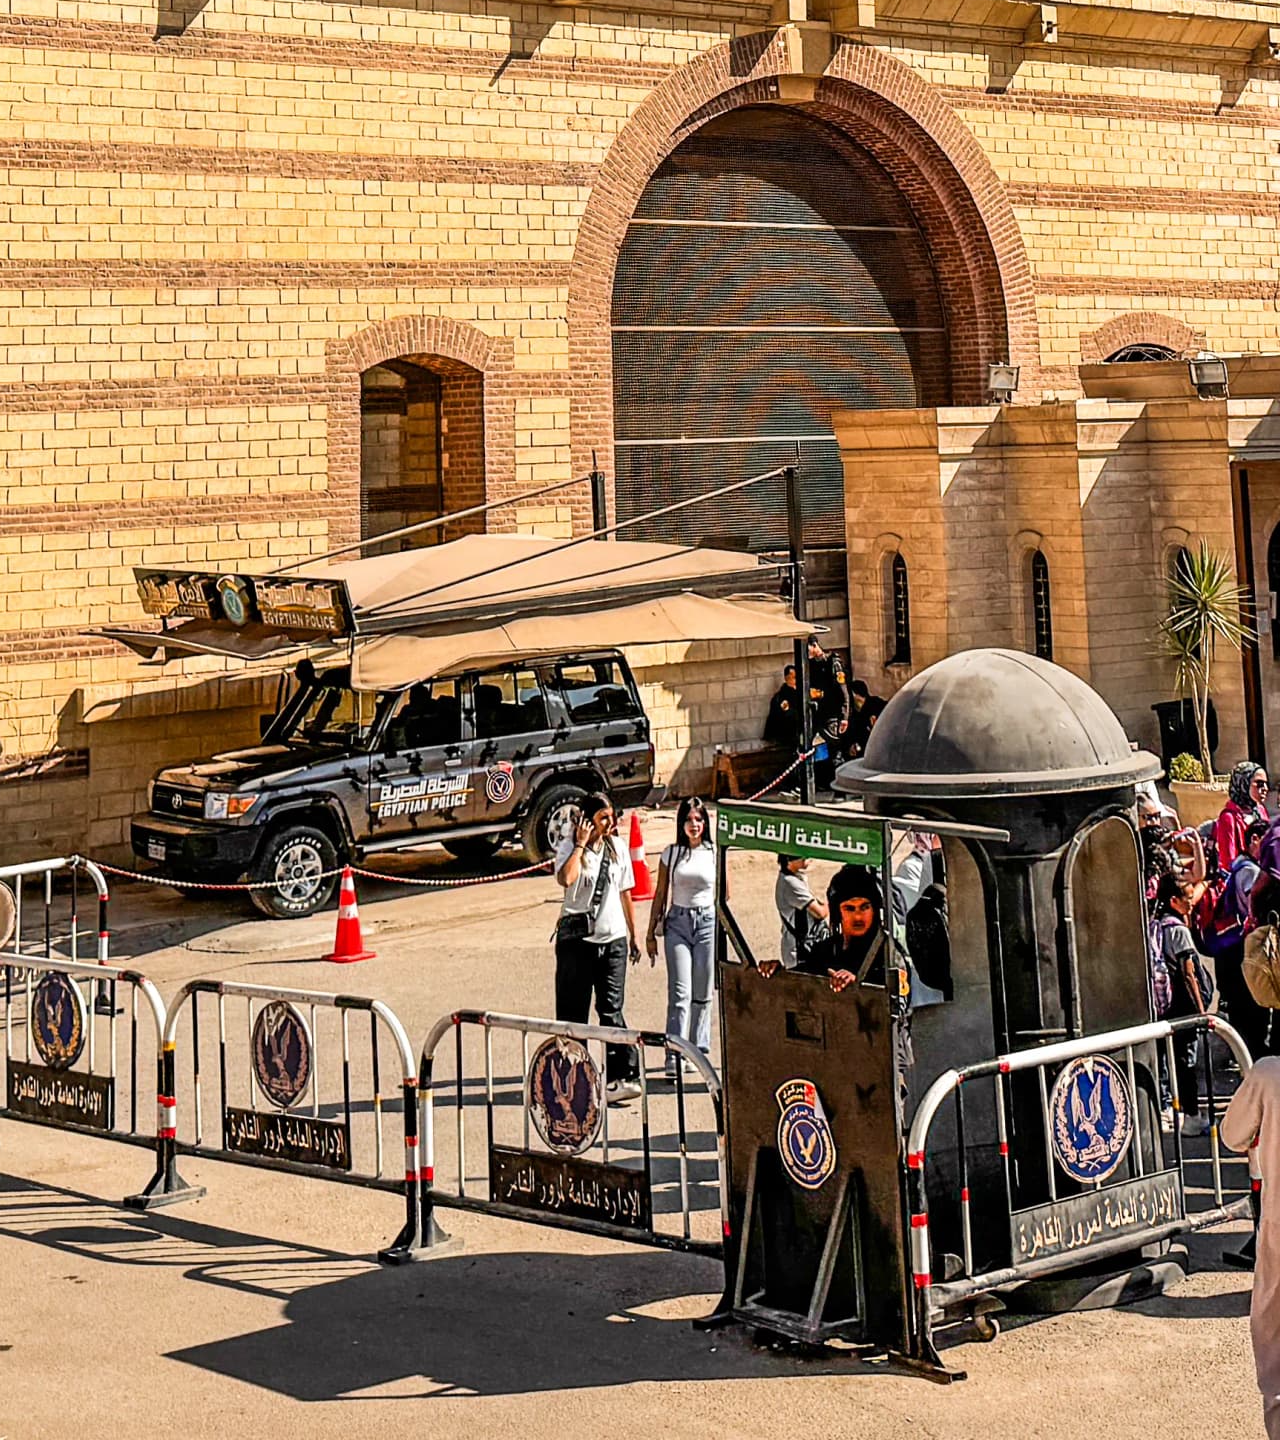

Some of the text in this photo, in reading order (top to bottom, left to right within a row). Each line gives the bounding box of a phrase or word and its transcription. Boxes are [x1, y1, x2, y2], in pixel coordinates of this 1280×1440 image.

[262, 611, 335, 629] EGYPTIAN POLICE
[378, 793, 468, 819] EGYPTIAN POLICE
[718, 814, 868, 855] منطقة القاهرة
[1020, 1186, 1178, 1259] الإدارة العامة لمرور القاهرة
